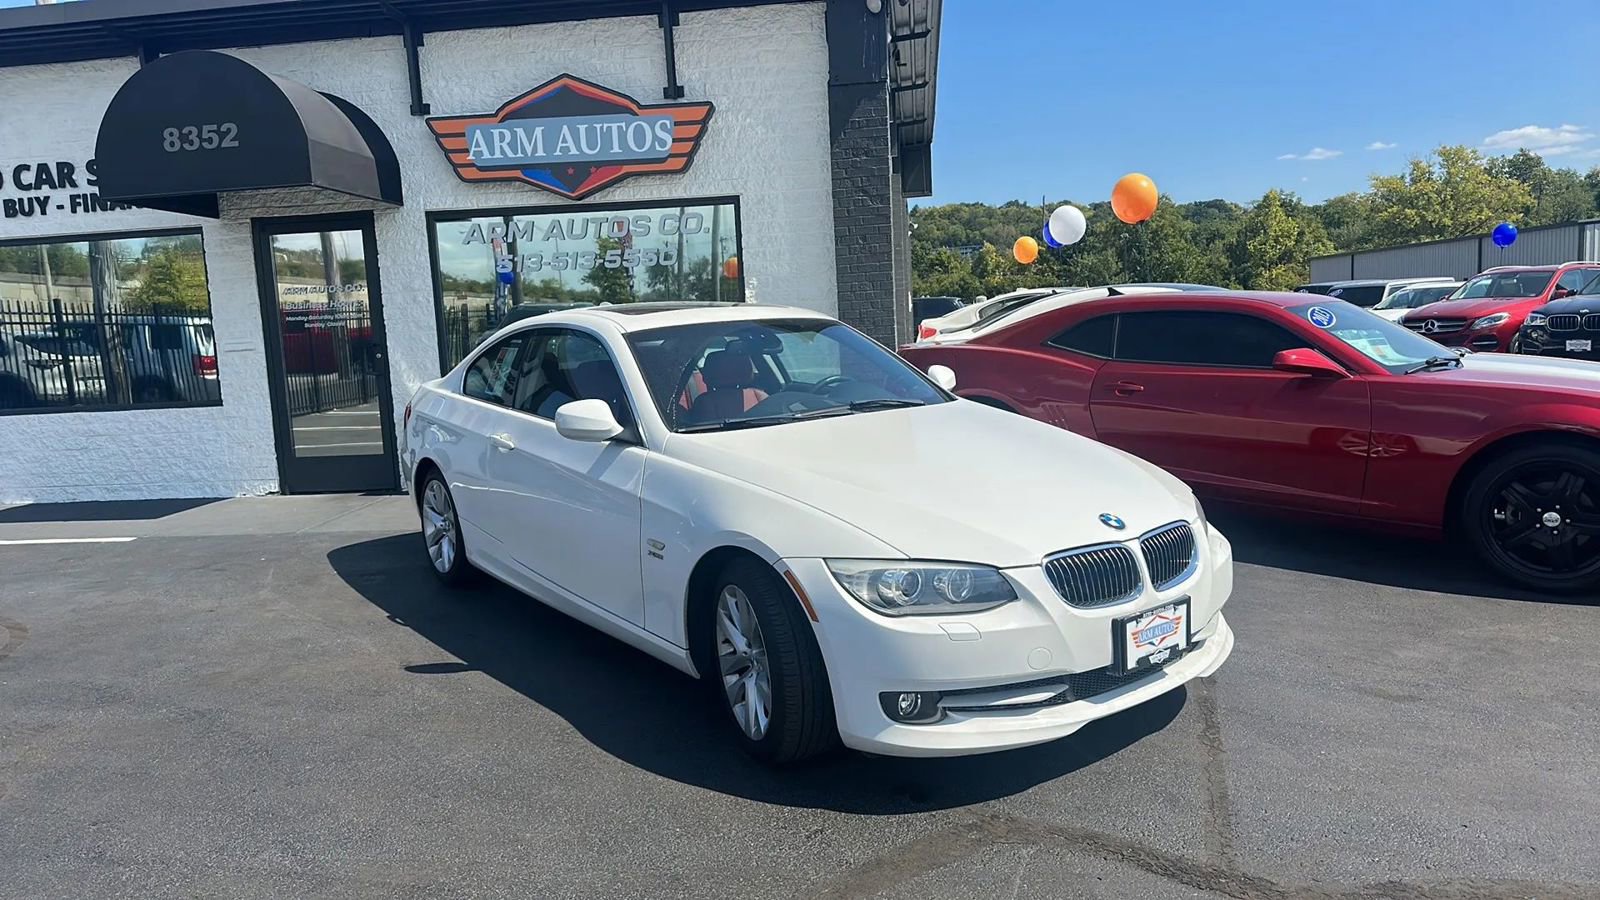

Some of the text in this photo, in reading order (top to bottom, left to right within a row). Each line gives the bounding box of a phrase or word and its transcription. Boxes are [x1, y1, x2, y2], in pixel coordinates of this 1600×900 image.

[163, 122, 240, 152] 8352
[467, 119, 673, 160] ARM AUTOS
[12, 161, 79, 192] CAR
[3, 195, 51, 219] BUY
[462, 212, 710, 246] ARM AUTOS CO.
[495, 247, 679, 274] 513-513-5550
